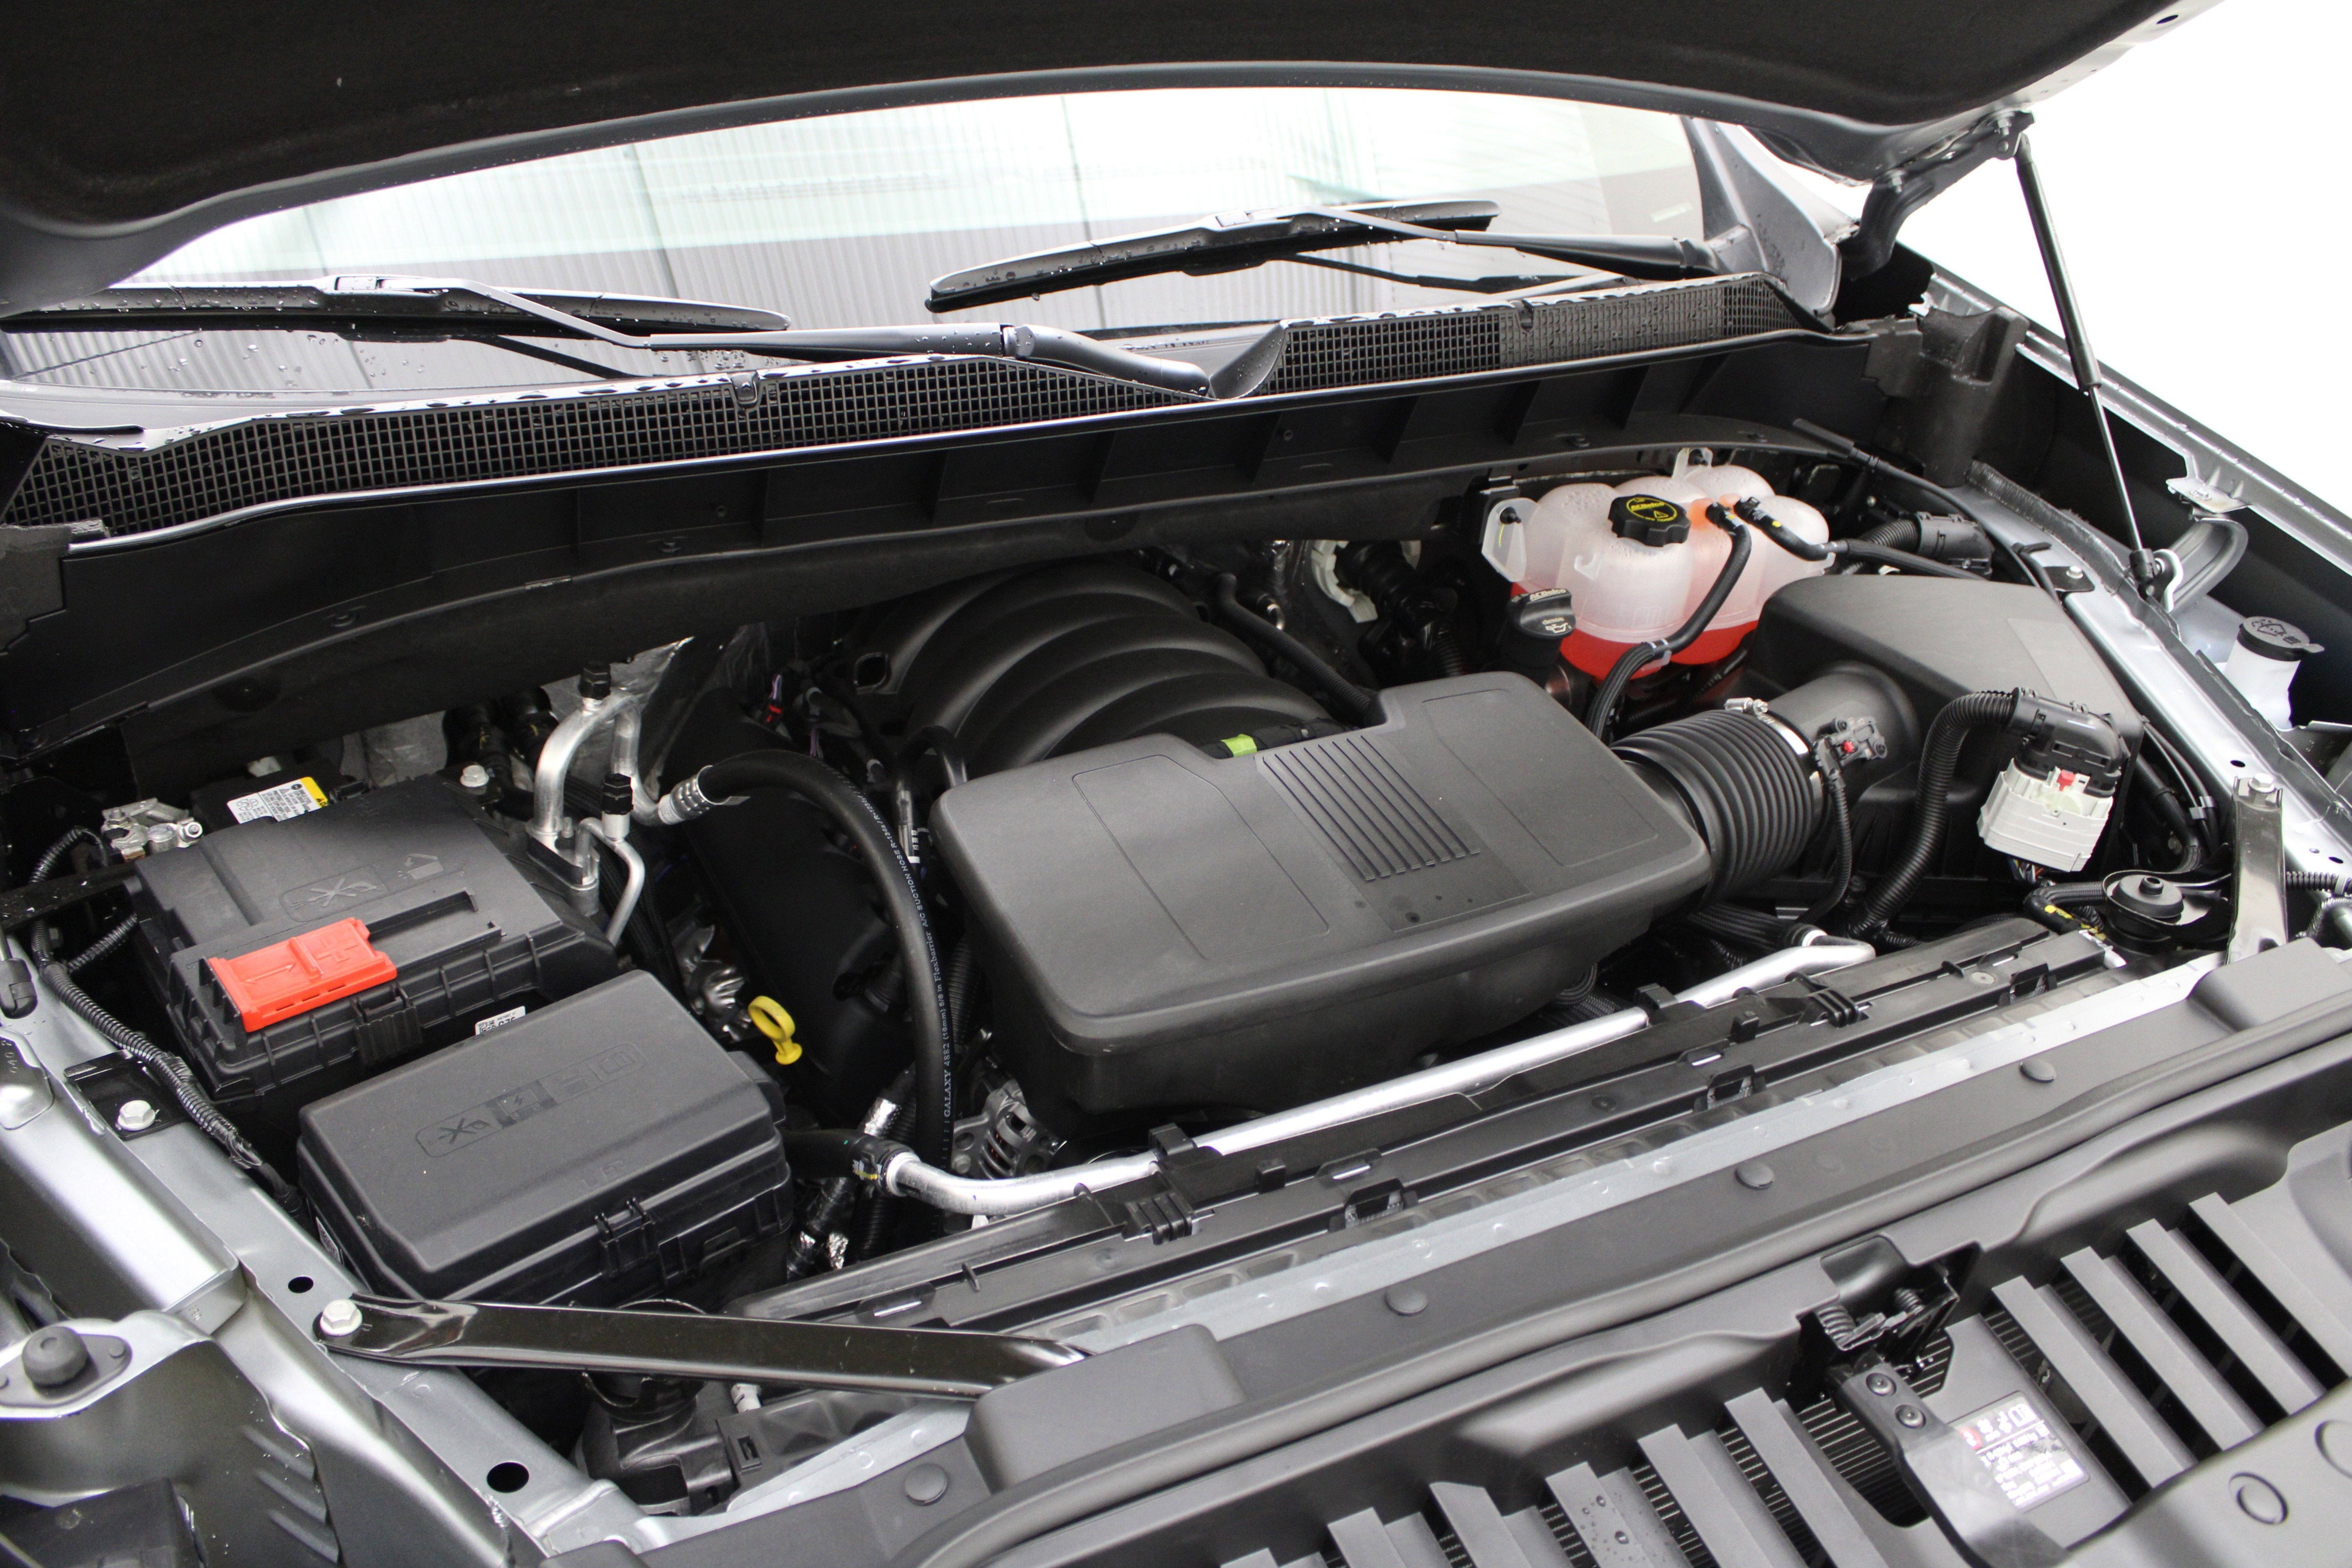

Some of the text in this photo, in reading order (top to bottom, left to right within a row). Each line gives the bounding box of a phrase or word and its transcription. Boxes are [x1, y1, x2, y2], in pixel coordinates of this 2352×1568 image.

[1530, 588, 1567, 601] ACDelco
[858, 795, 880, 820] R-1234yf
[881, 825, 897, 848] R-134a
[894, 850, 909, 871] HOSE
[905, 873, 923, 910] SUCTION
[920, 913, 929, 927] A/C
[925, 932, 941, 981] Flexbarrier
[940, 1009, 948, 1039] (16mm)
